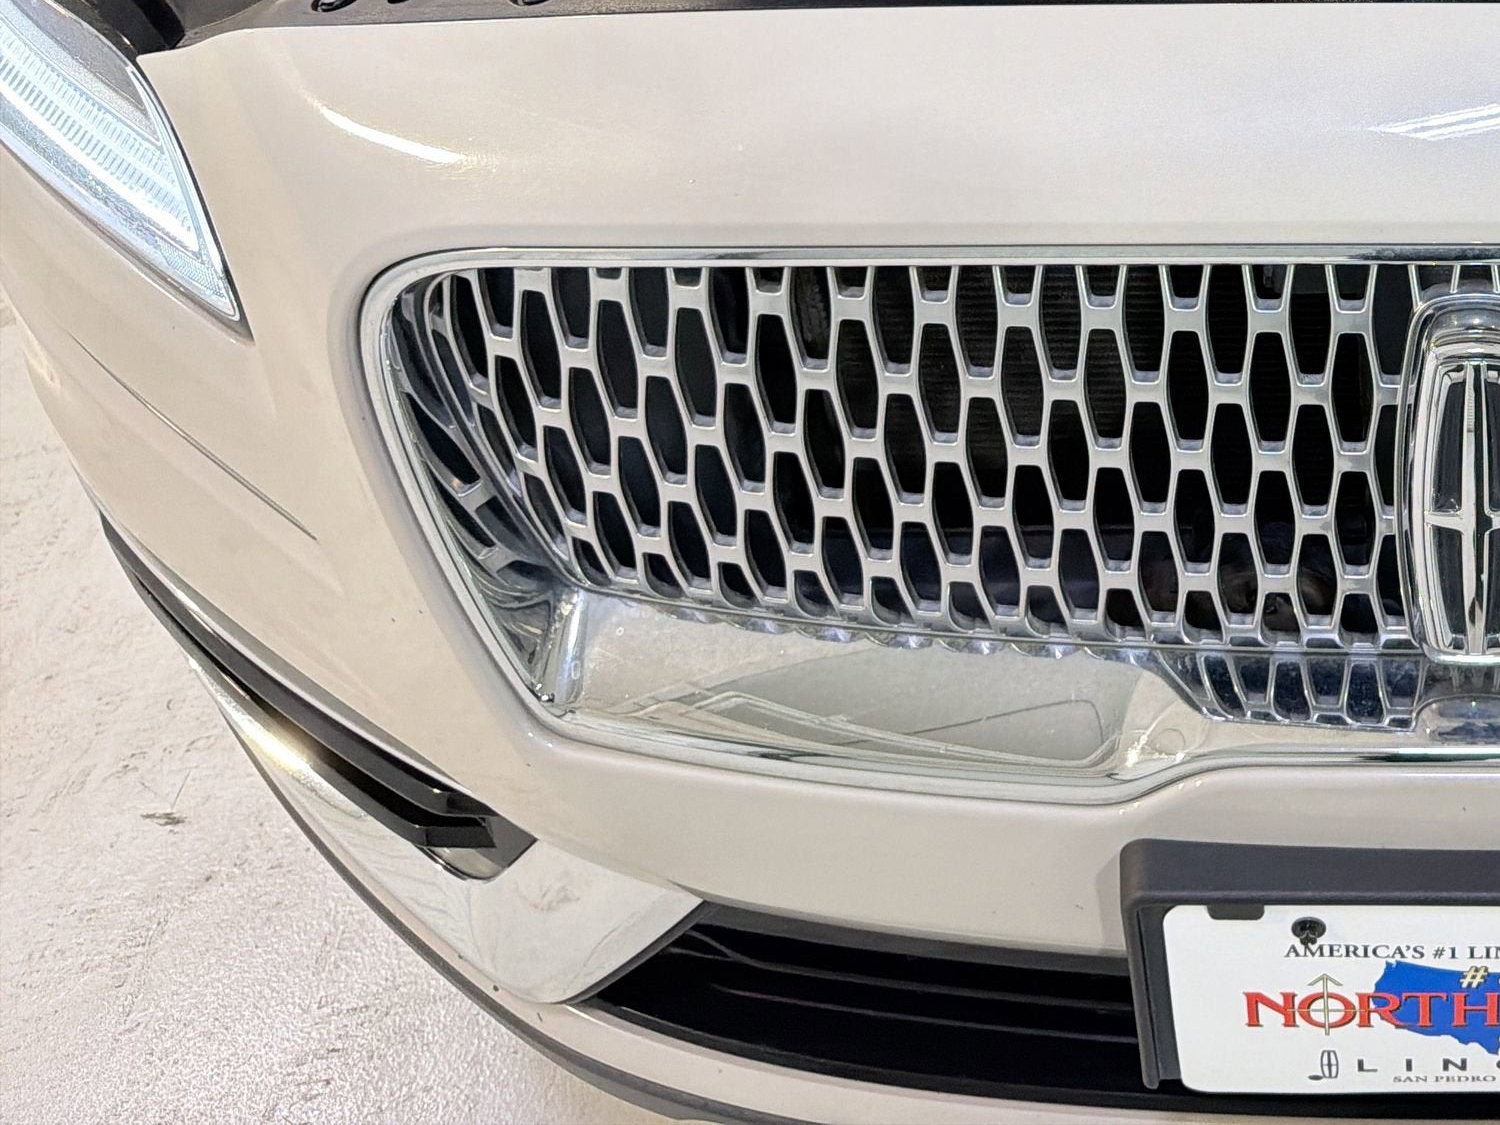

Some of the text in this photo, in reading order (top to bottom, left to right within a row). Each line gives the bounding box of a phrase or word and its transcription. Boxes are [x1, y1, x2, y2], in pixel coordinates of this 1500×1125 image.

[1283, 944, 1426, 960] AMERICA'S
[1432, 945, 1459, 960] #1
[1243, 991, 1500, 1028] NORTH
[1392, 1075, 1428, 1083] SAN
[1434, 1075, 1496, 1083] PEDRO
